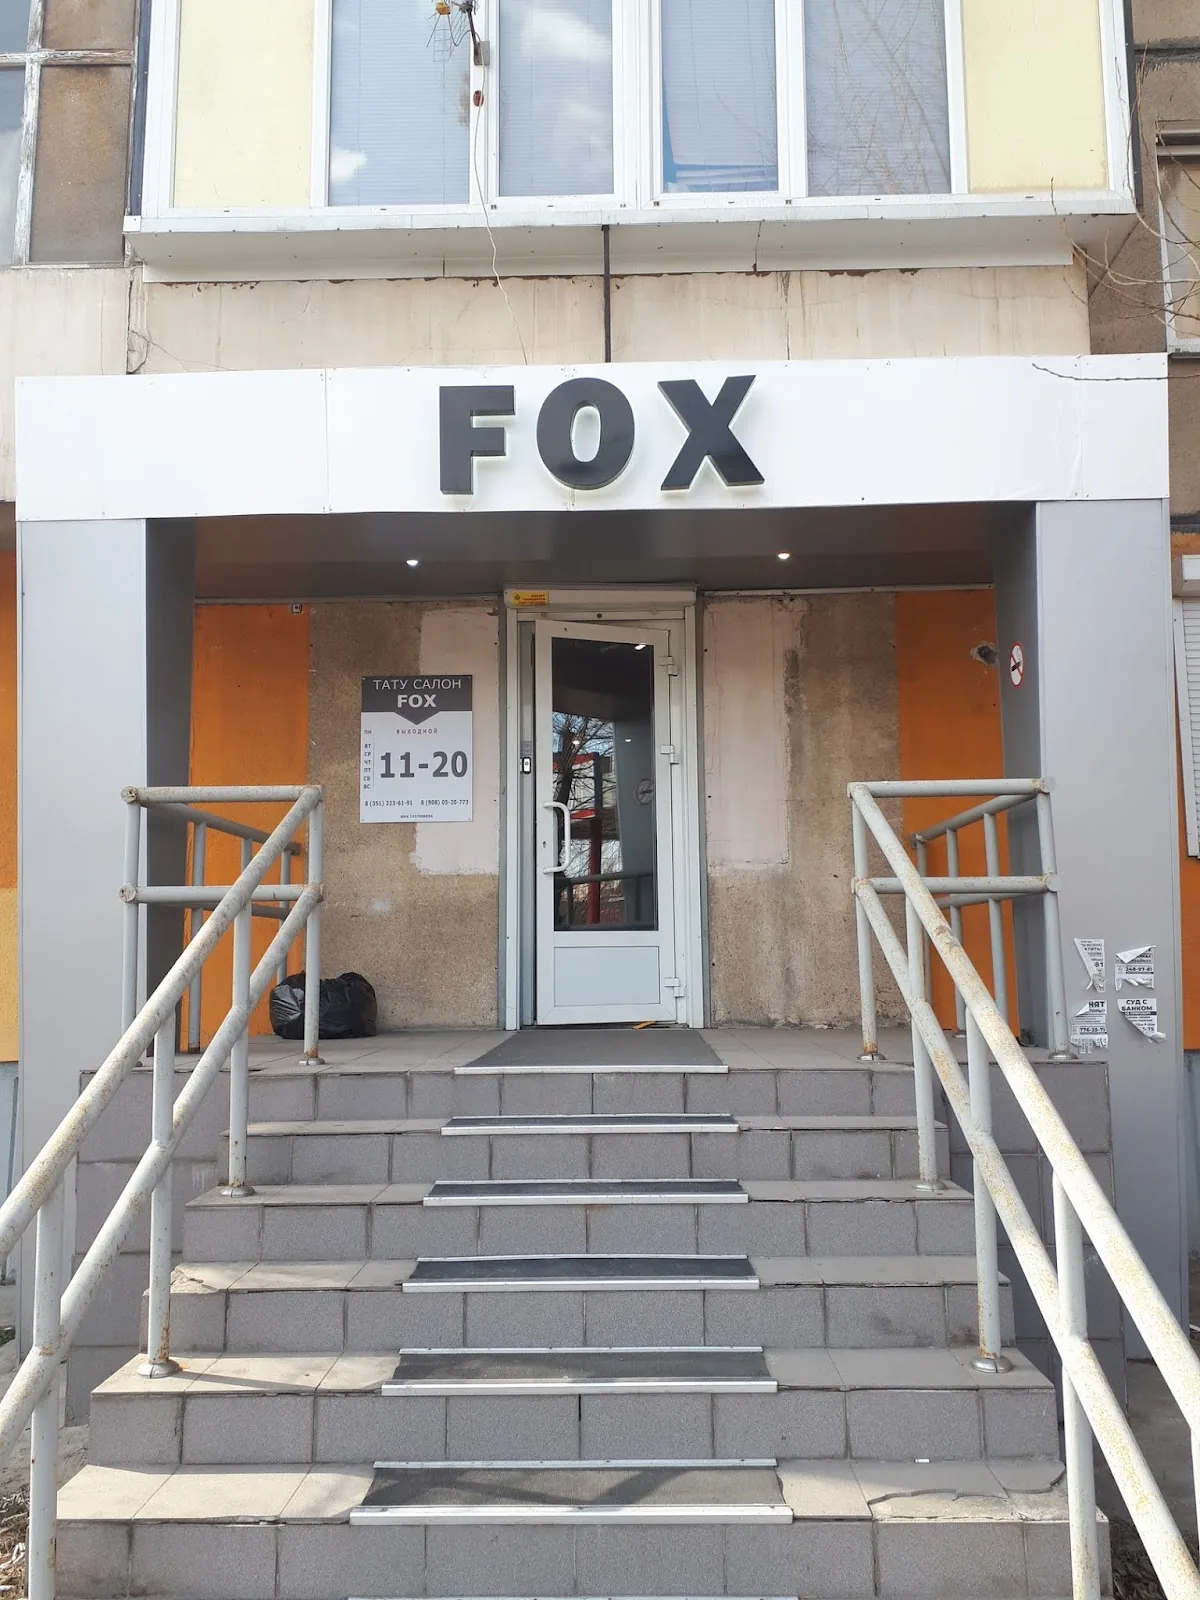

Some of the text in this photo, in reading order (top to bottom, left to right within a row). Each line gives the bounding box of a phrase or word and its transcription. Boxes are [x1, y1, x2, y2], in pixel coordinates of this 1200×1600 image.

[438, 374, 766, 496] FOX
[373, 678, 462, 690] ТАТУ САЛОН
[397, 694, 437, 708] FOX
[380, 750, 468, 778] 11-20
